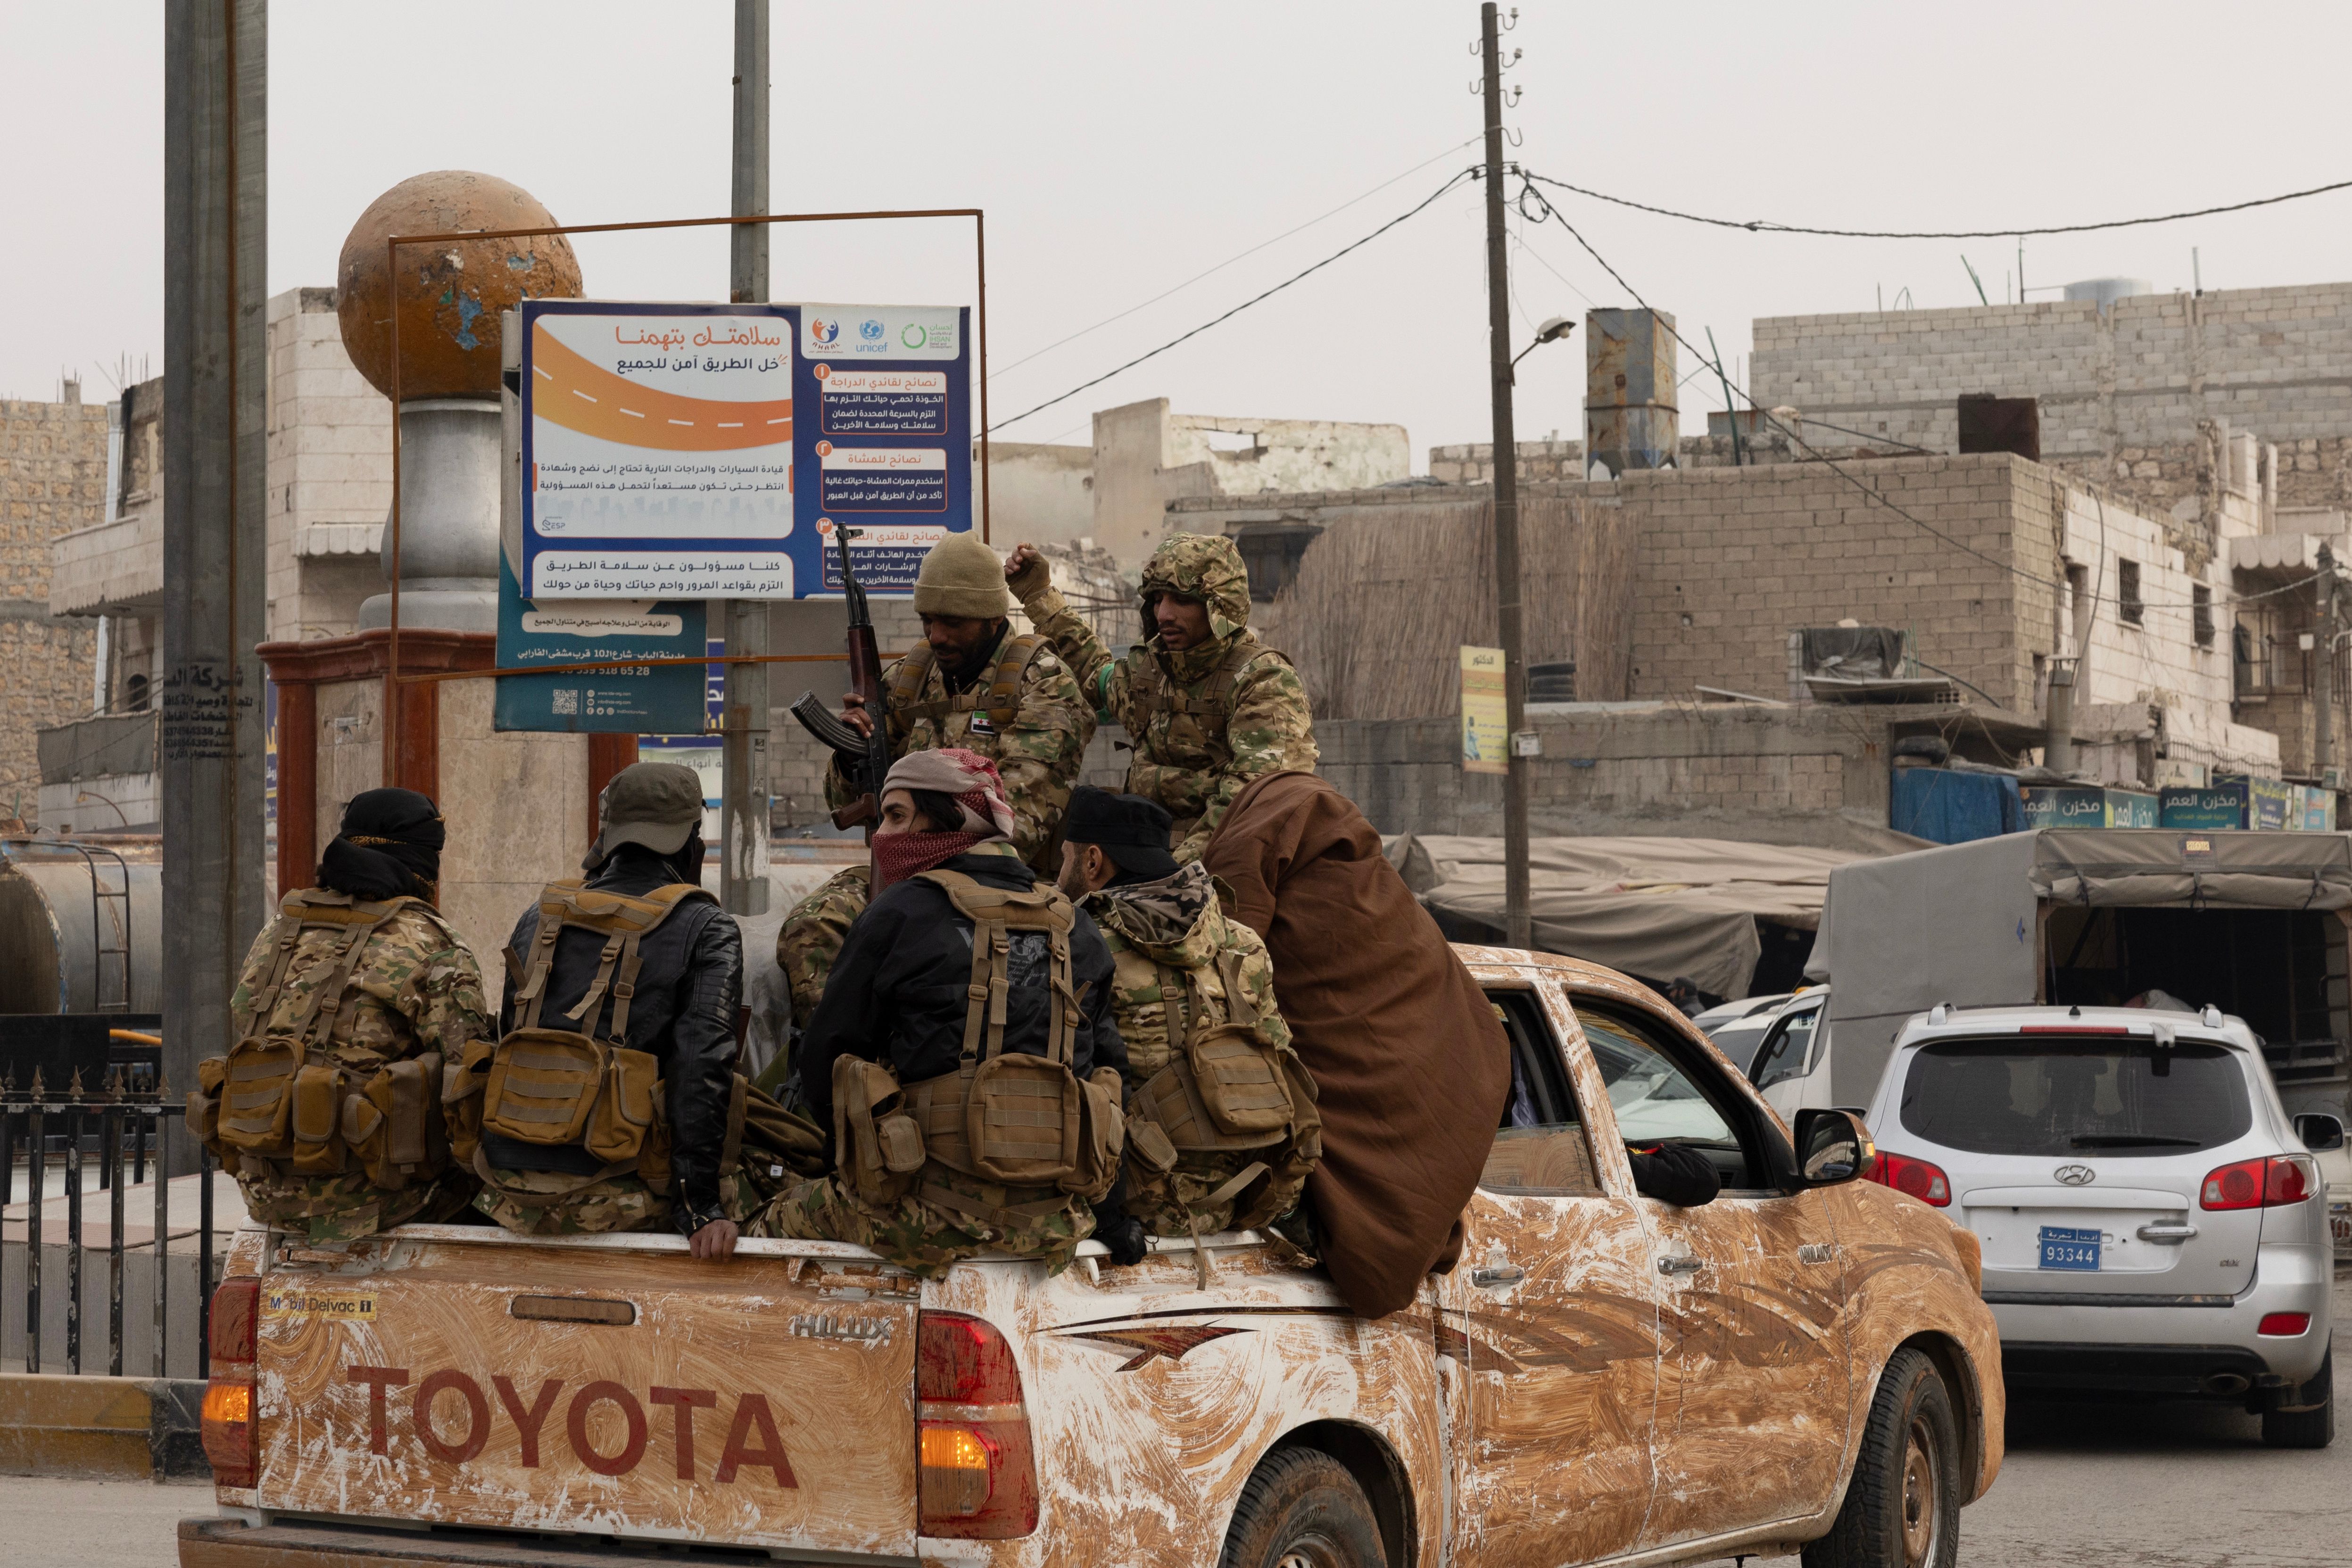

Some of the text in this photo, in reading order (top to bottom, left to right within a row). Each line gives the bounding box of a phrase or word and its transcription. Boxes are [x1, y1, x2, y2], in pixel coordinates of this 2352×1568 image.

[616, 325, 780, 351] سلامتك بتهمنا
[856, 342, 888, 353] unicef
[617, 355, 778, 374] خل الطريق آمن للجميع
[831, 378, 936, 391] نصائح لقائدي الدراجة
[824, 395, 838, 404] بها
[840, 395, 860, 404] التزم
[890, 395, 913, 405] تحمي
[916, 395, 943, 403] الخوذة
[832, 410, 857, 418] لضمان
[889, 410, 918, 419] بالسرعة
[919, 410, 936, 420] التزم
[865, 421, 898, 430] وسلامة
[848, 454, 921, 467] نصائح للمشاة
[541, 463, 783, 475] قيادة السيارات والدراجات النارية تحتاج إلى نضج وشهادة
[540, 481, 592, 490] المسؤولية
[825, 477, 842, 485] غالية
[893, 478, 915, 486] ممرات
[915, 477, 943, 487] استخدم
[618, 482, 650, 491] لتحمل
[699, 482, 726, 491] تكون
[729, 484, 753, 492] حتى
[754, 483, 784, 491] انتظر
[827, 492, 848, 500] العبور
[850, 491, 863, 500] قبل
[866, 490, 878, 500] آمن
[880, 492, 904, 500] الطريق
[906, 490, 914, 500] أن
[928, 491, 942, 499] تأكد
[877, 532, 909, 545] لقائدي
[856, 550, 875, 558] أثناء
[547, 561, 780, 572] كلنا مسؤولون عن سلامة الطريق
[875, 563, 916, 571] الإشارات
[543, 580, 783, 592] التزم بقواعد المرور واحم حياتك وحياة من حولك
[535, 619, 556, 627] الجميع
[586, 619, 602, 627] أصبح
[602, 619, 625, 627] وعلاجه
[518, 649, 547, 659] الفارابي
[549, 648, 572, 658] مشفى
[573, 649, 590, 658] قرب
[661, 650, 685, 659] مدينة
[621, 667, 634, 676] 65
[637, 667, 650, 676] 28
[2165, 794, 2236, 809] مخزن العمر
[2062, 799, 2100, 817] مخزن
[2047, 1246, 2094, 1263] 93344
[309, 1298, 355, 1312] Delvac
[794, 1314, 892, 1340] HILUX
[347, 1365, 798, 1489] TOYOTA
